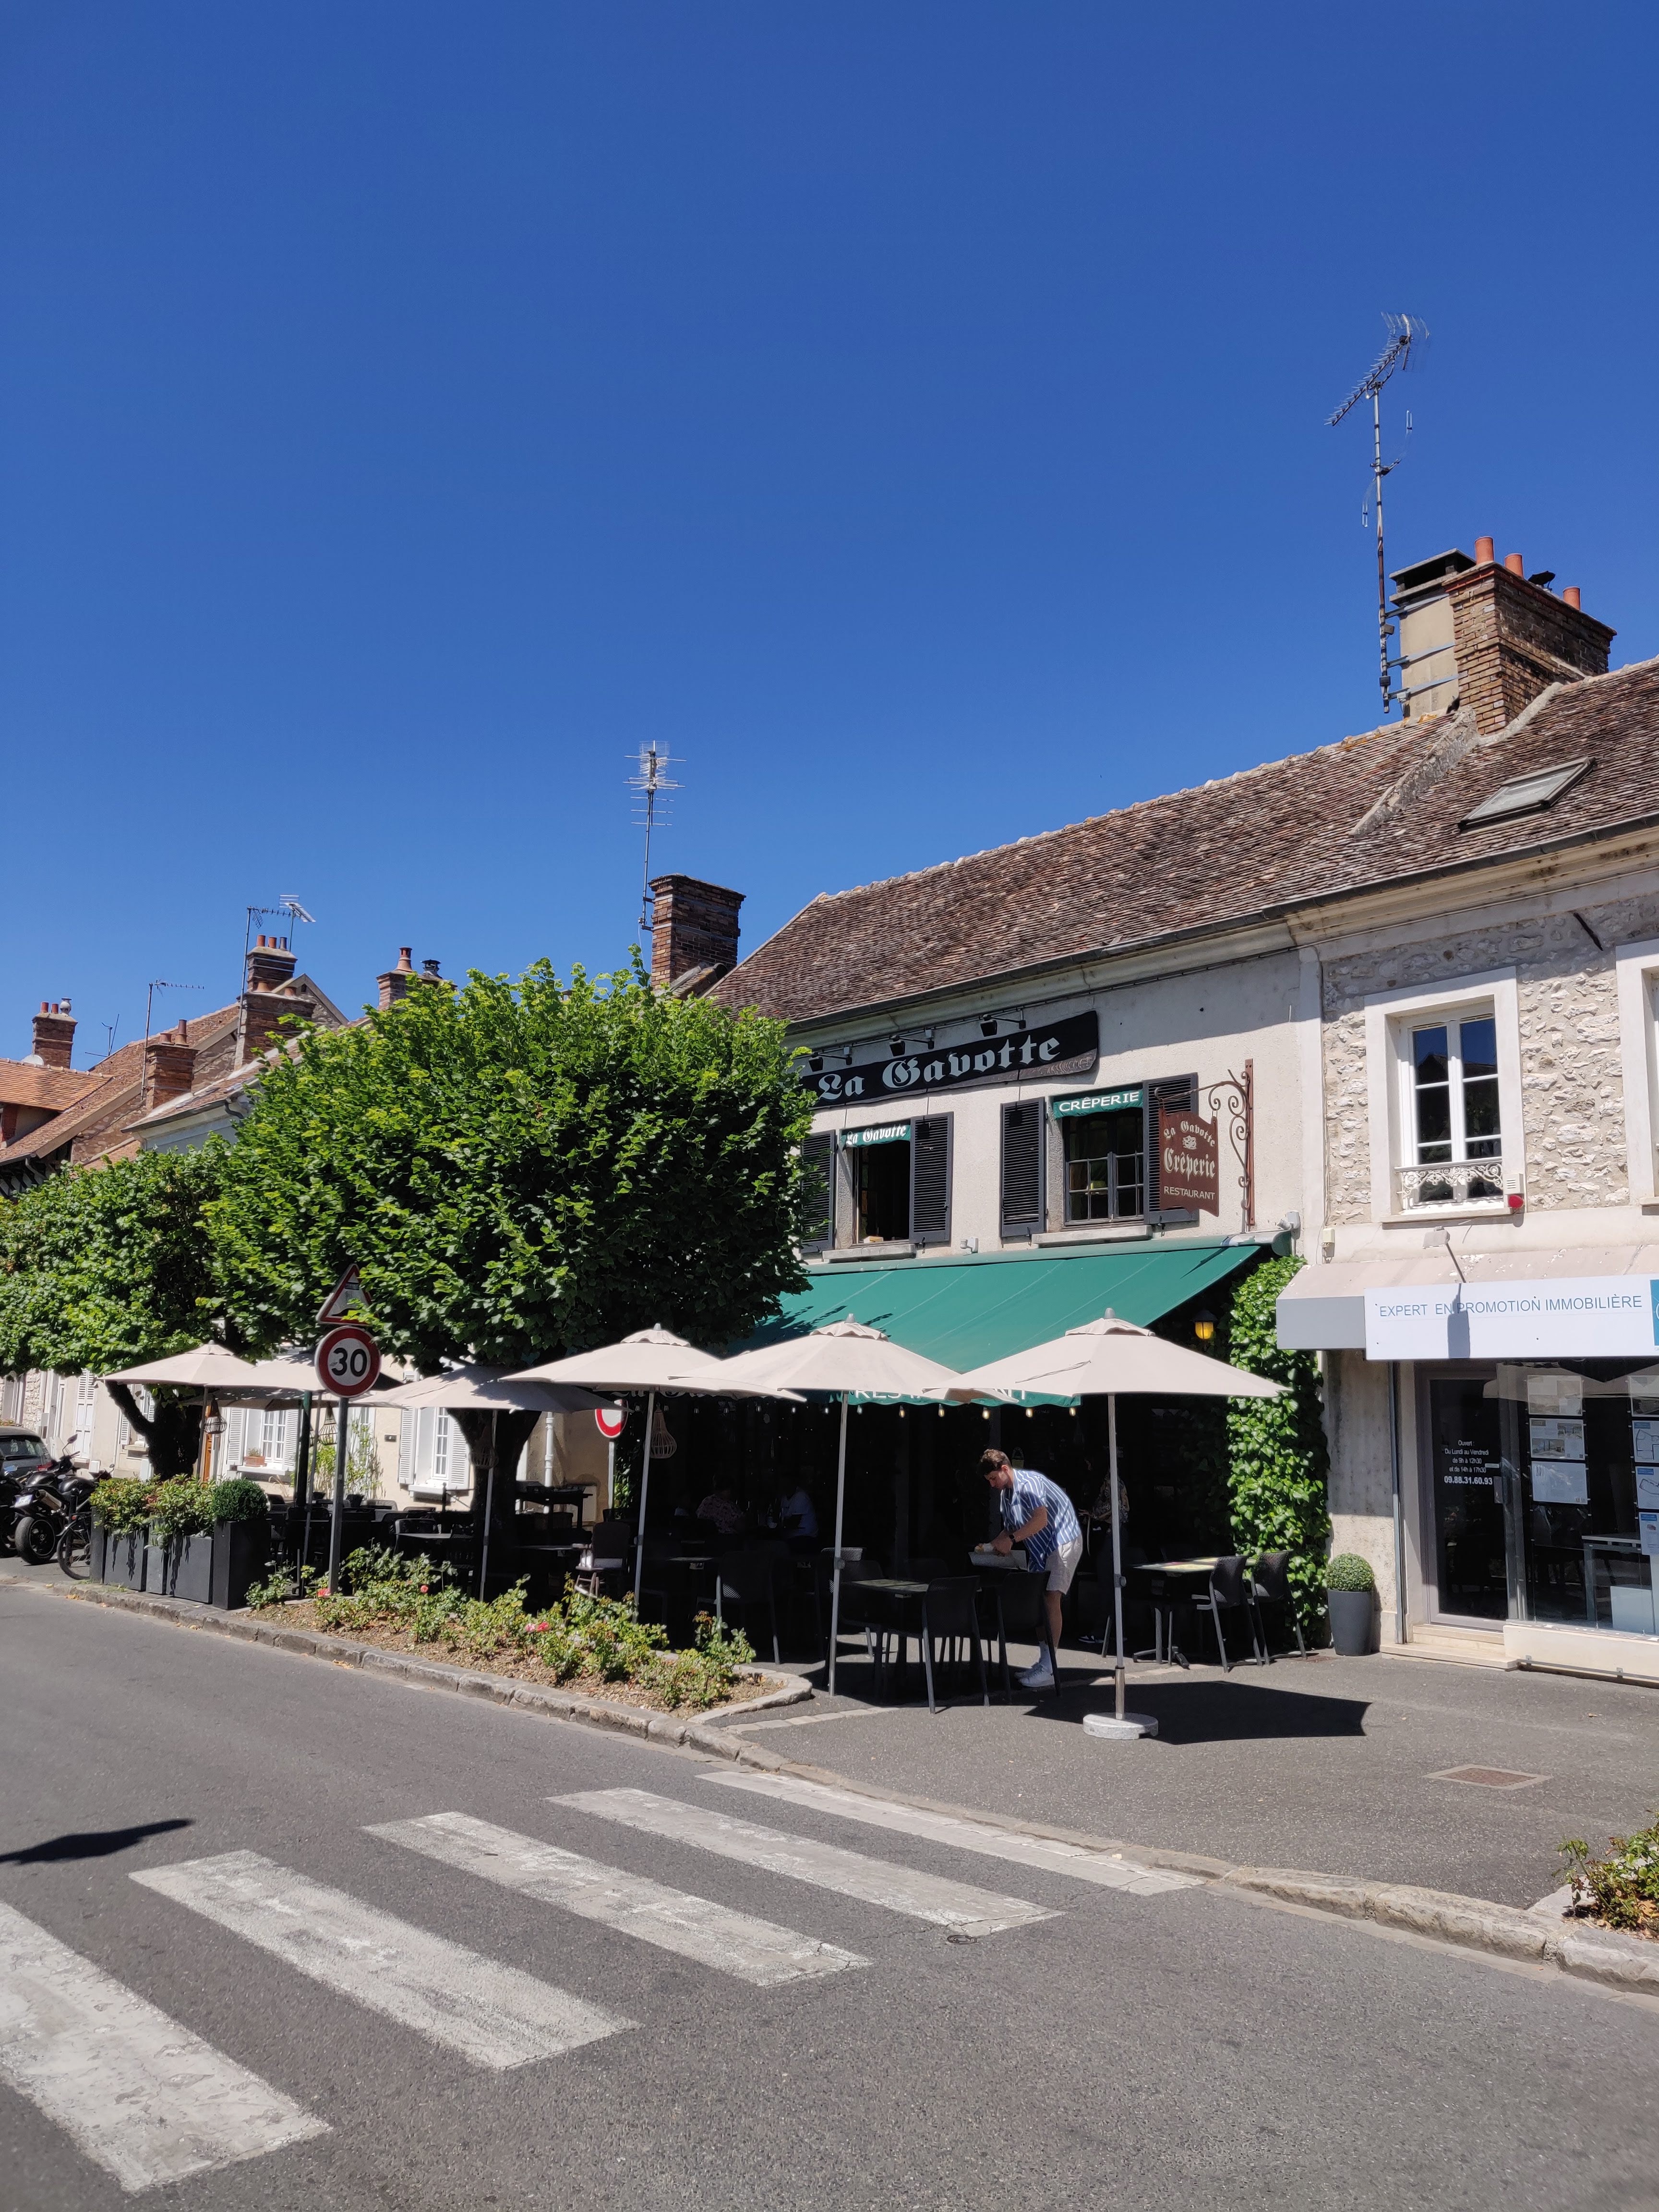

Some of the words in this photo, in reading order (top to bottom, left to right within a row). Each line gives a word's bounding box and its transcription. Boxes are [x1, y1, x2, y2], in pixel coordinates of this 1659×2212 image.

[818, 1073, 865, 1100] La
[882, 1034, 1061, 1089] Gavotte
[1059, 1092, 1140, 1112] CRÊPERIE
[845, 1131, 858, 1145] La
[862, 1123, 907, 1142] Gavotte
[1163, 1127, 1176, 1139] La
[1180, 1120, 1215, 1147] Gavotte
[1164, 1147, 1215, 1183] Crêperie
[1164, 1186, 1215, 1200] RESTAURANT
[1379, 1304, 1428, 1317] EXPERT
[1435, 1303, 1453, 1315] EN
[1456, 1298, 1540, 1314] PROMOTION
[1545, 1293, 1642, 1311] IMMOBILIÈRE
[331, 1347, 368, 1377] 30
[1444, 1476, 1493, 1485] 09.88.31.60.93
